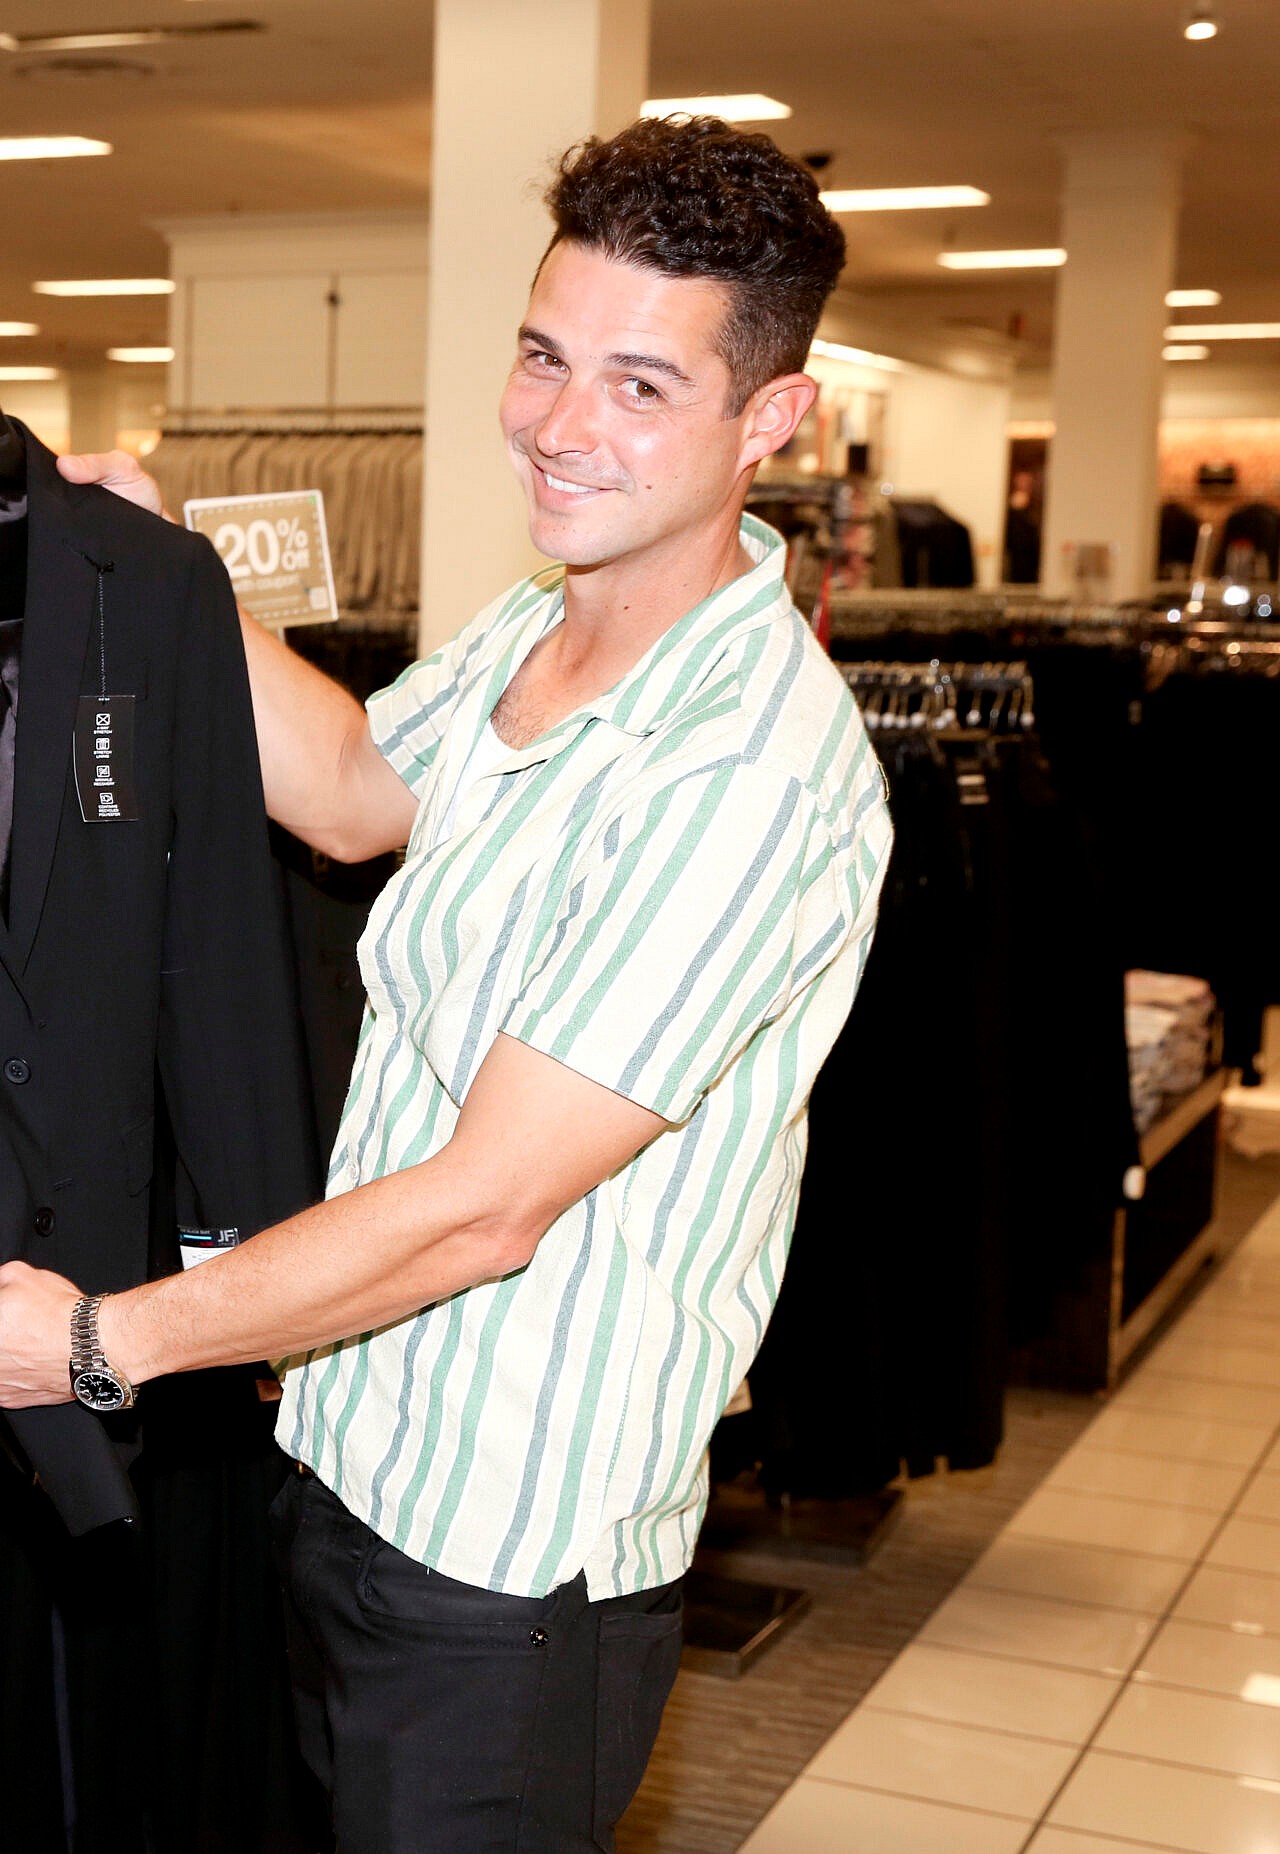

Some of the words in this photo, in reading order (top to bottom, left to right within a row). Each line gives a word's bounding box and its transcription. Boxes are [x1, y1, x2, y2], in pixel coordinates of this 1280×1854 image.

[215, 516, 308, 577] 20%
[281, 549, 310, 571] Off
[218, 1229, 234, 1242] JF
